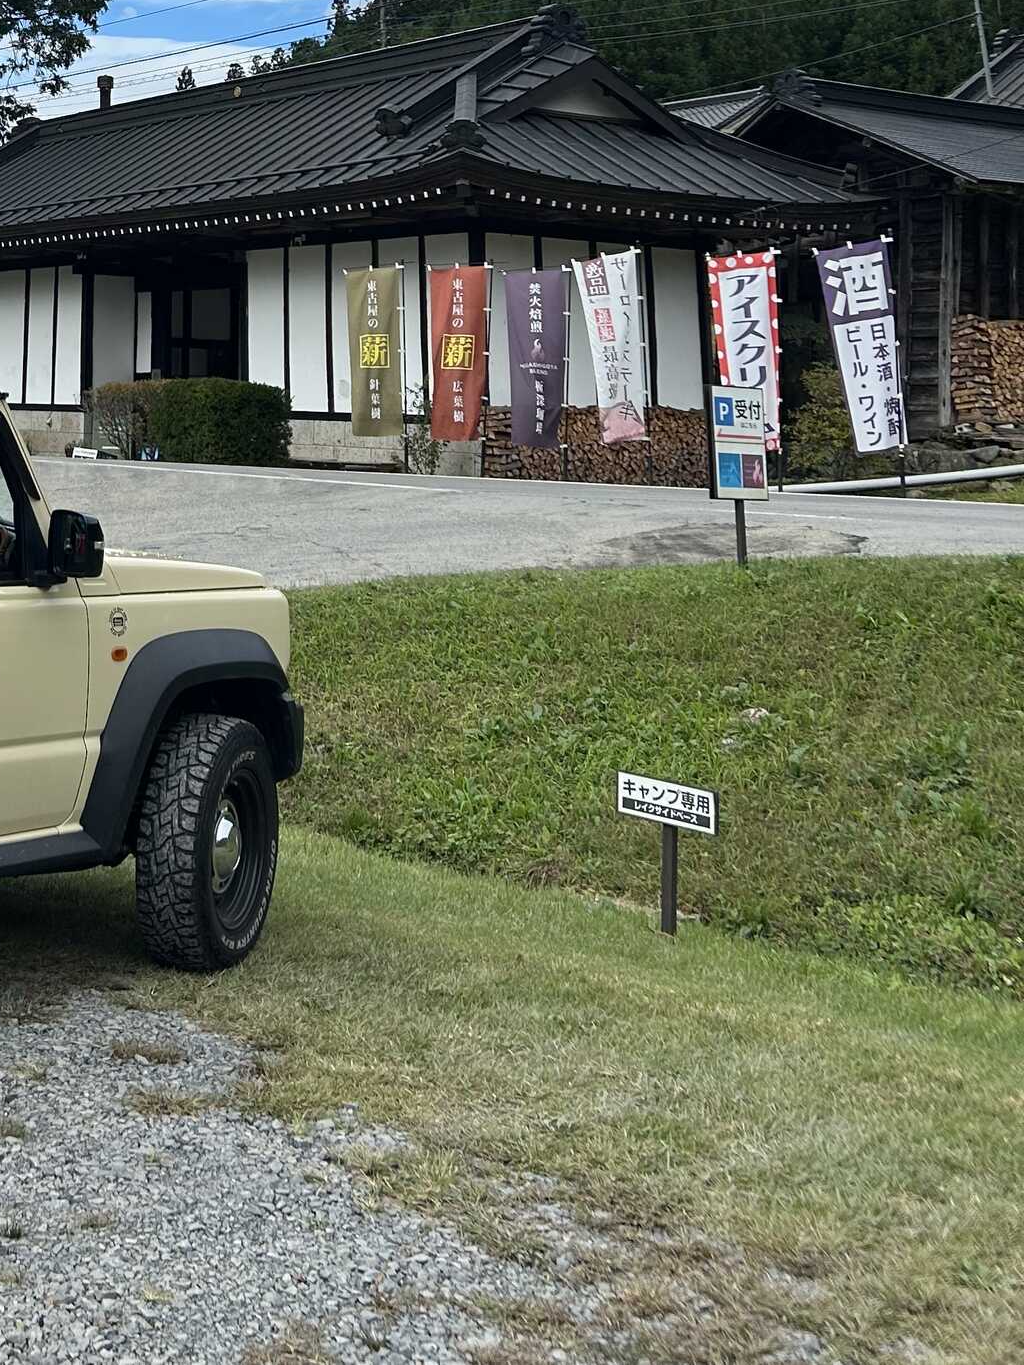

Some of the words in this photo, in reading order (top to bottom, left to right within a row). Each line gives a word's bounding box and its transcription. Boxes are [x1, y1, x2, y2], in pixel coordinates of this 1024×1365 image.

[824, 251, 888, 316] 酒
[367, 280, 379, 329] 東古屋の
[451, 278, 464, 328] 東古屋の
[362, 336, 388, 366] 薪
[443, 336, 473, 368] 薪
[845, 326, 882, 447] ビール・ワイン
[719, 402, 729, 421] P
[734, 399, 761, 420] 受付
[623, 779, 710, 815] キャンプ専用
